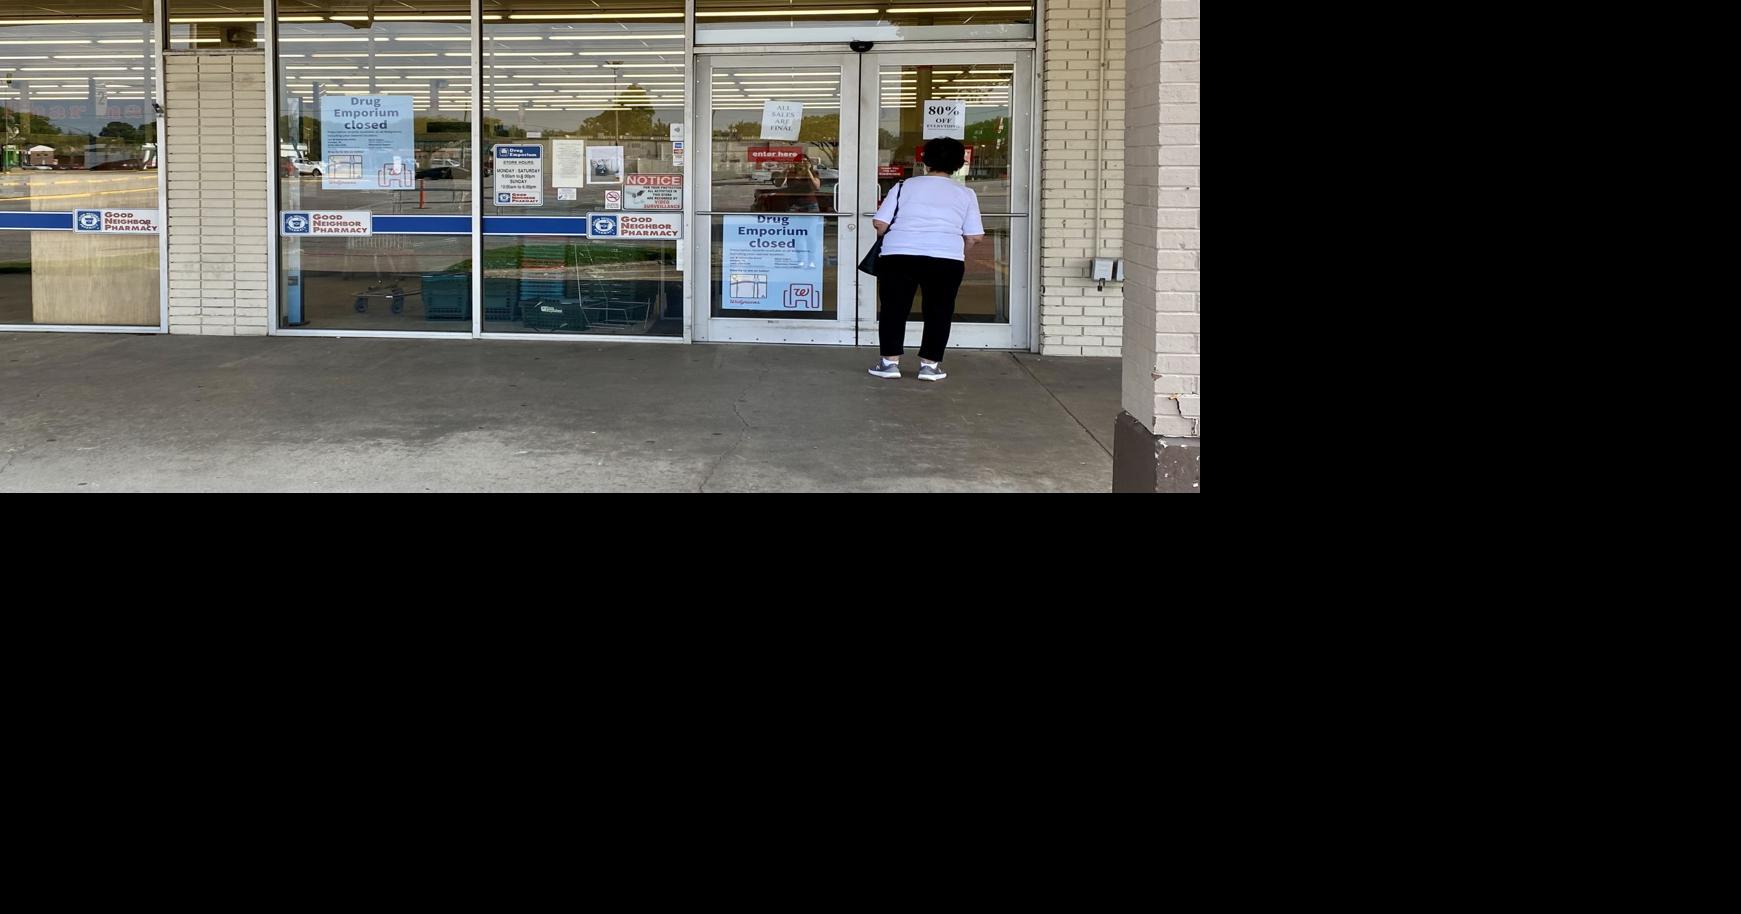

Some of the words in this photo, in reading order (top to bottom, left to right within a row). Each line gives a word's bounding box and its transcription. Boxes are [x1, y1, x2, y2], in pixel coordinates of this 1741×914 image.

[351, 97, 381, 108] Drug
[334, 108, 399, 119] Emporium
[928, 106, 960, 116] 80%
[344, 120, 388, 130] closed
[626, 176, 681, 185] NOTICE
[757, 215, 790, 226] Drug
[738, 226, 808, 237] Emporium
[749, 238, 796, 248] closed
